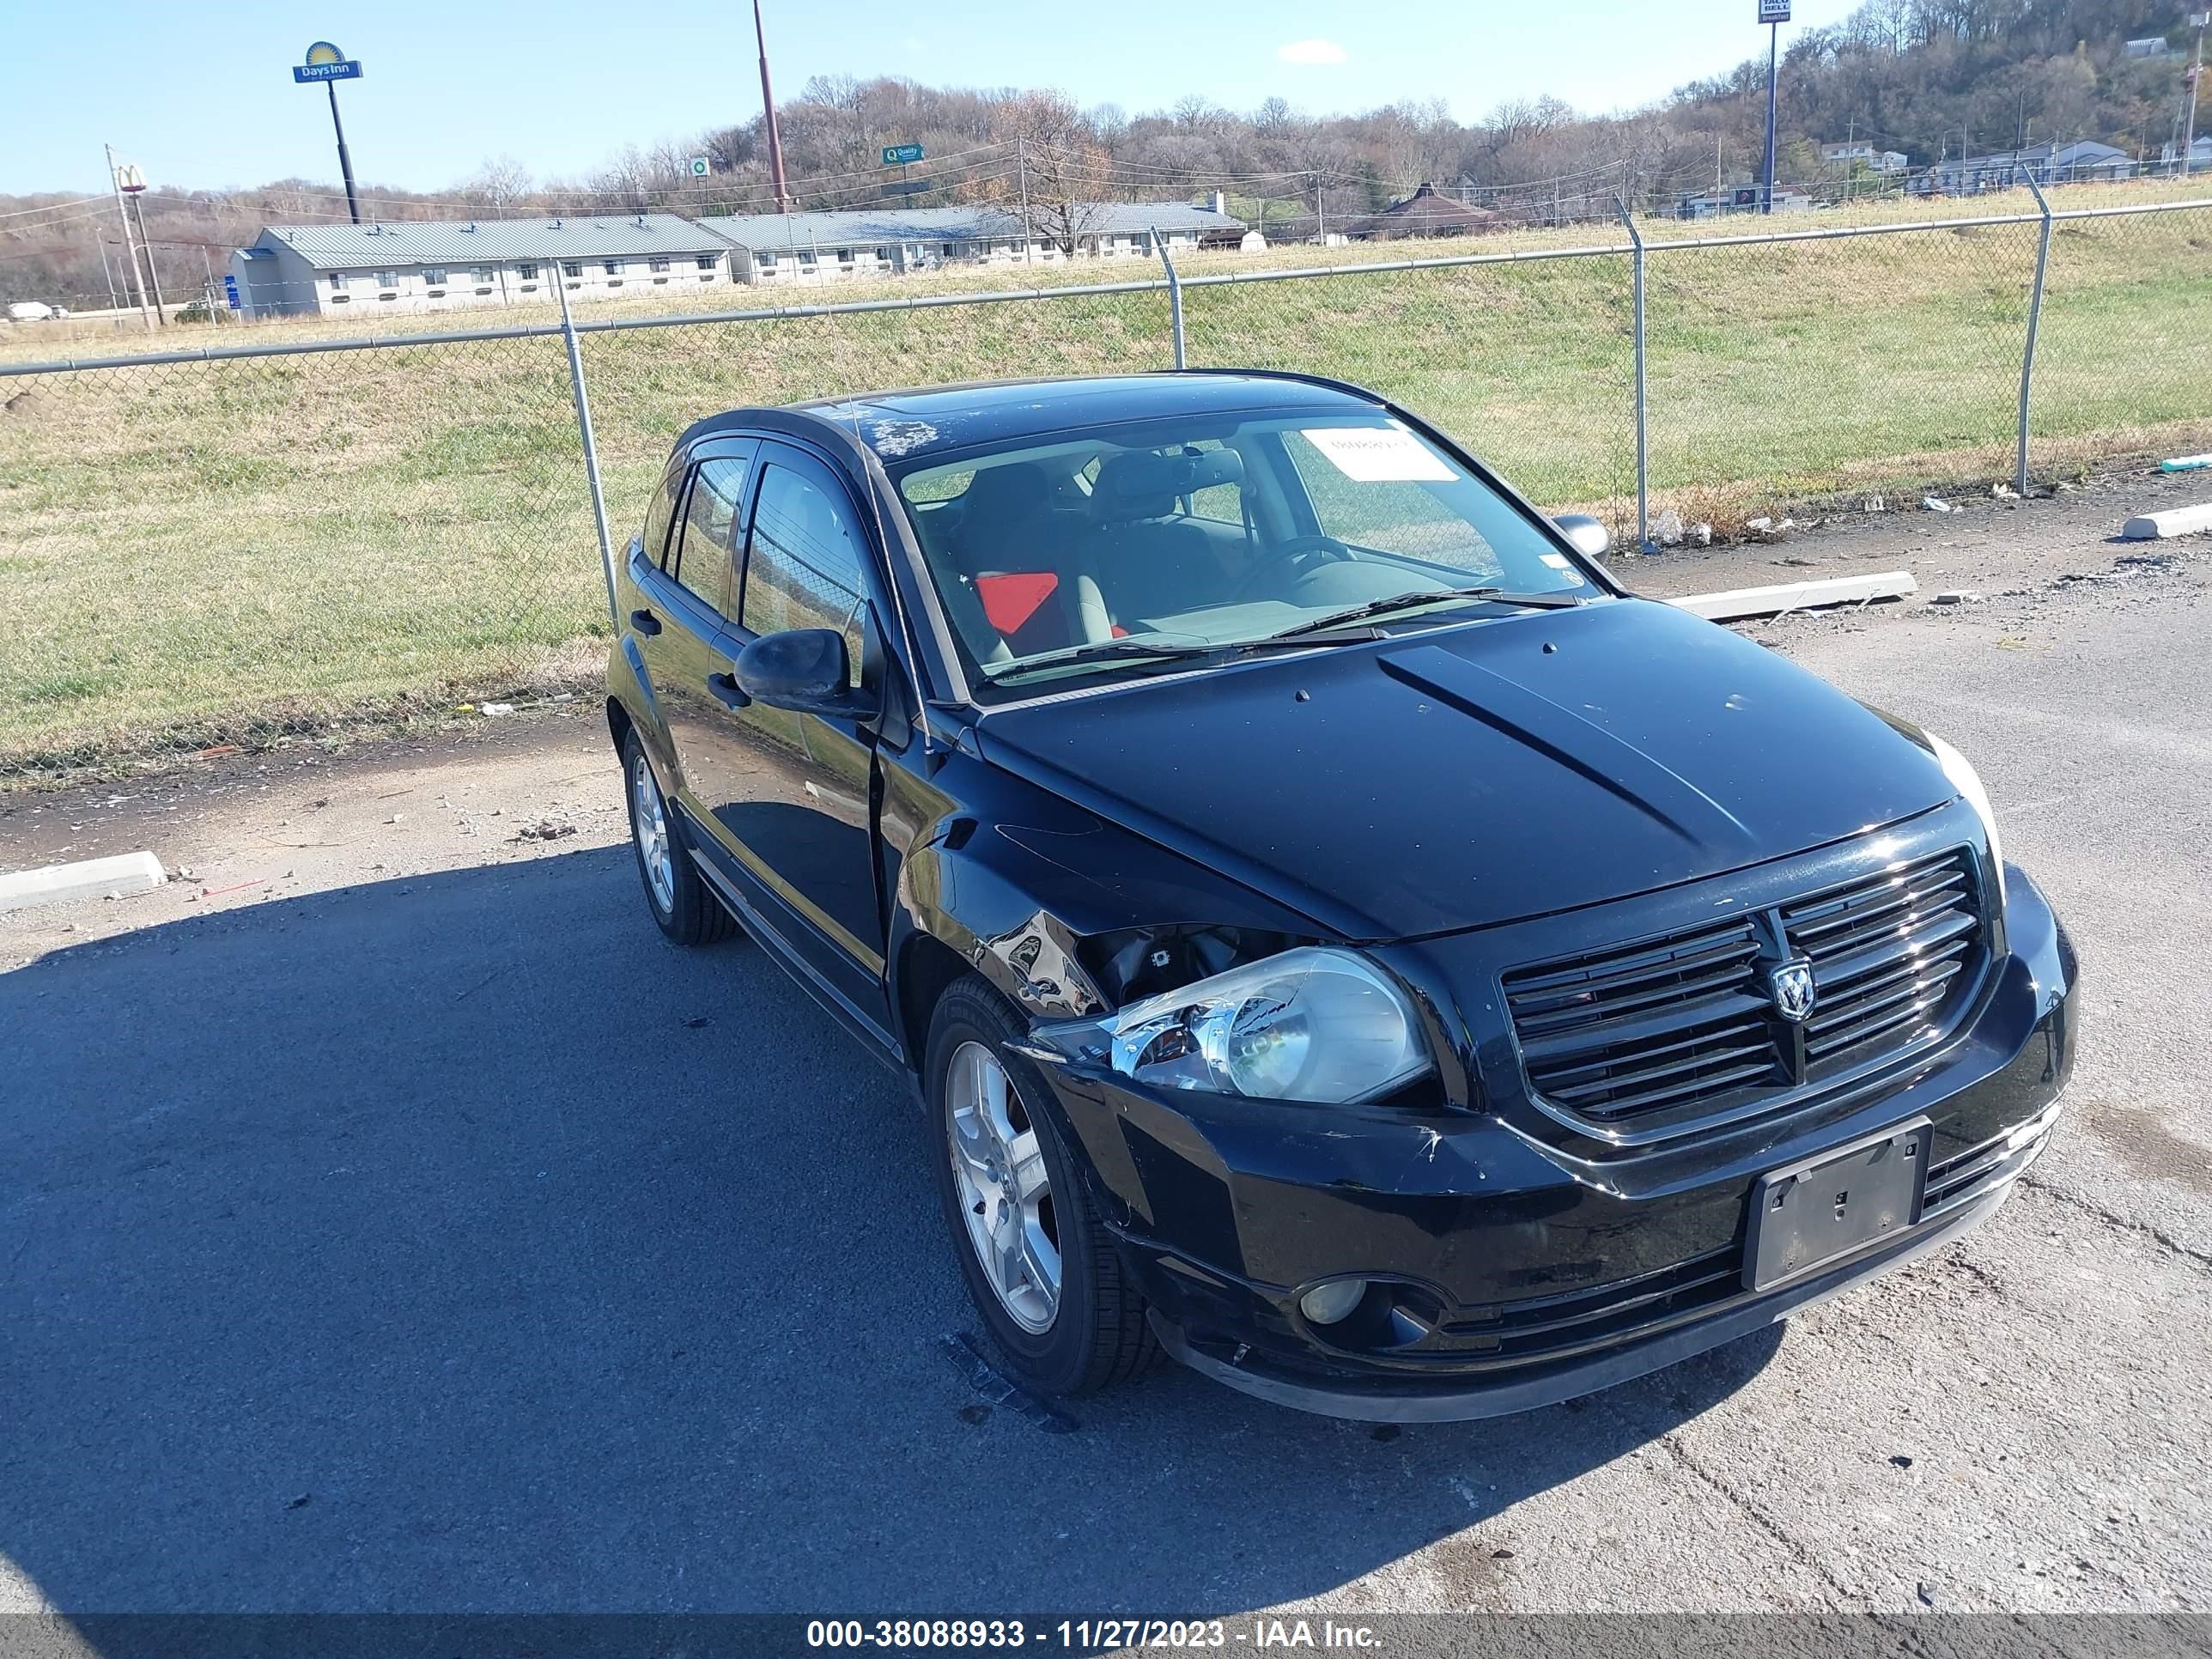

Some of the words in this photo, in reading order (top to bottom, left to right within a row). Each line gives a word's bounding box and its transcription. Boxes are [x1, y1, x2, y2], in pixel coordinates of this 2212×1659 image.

[1762, 13, 1790, 21] Breakfast
[301, 66, 330, 76] Days
[330, 64, 349, 74] Inn
[886, 149, 897, 161] Q
[897, 147, 917, 155] Quality
